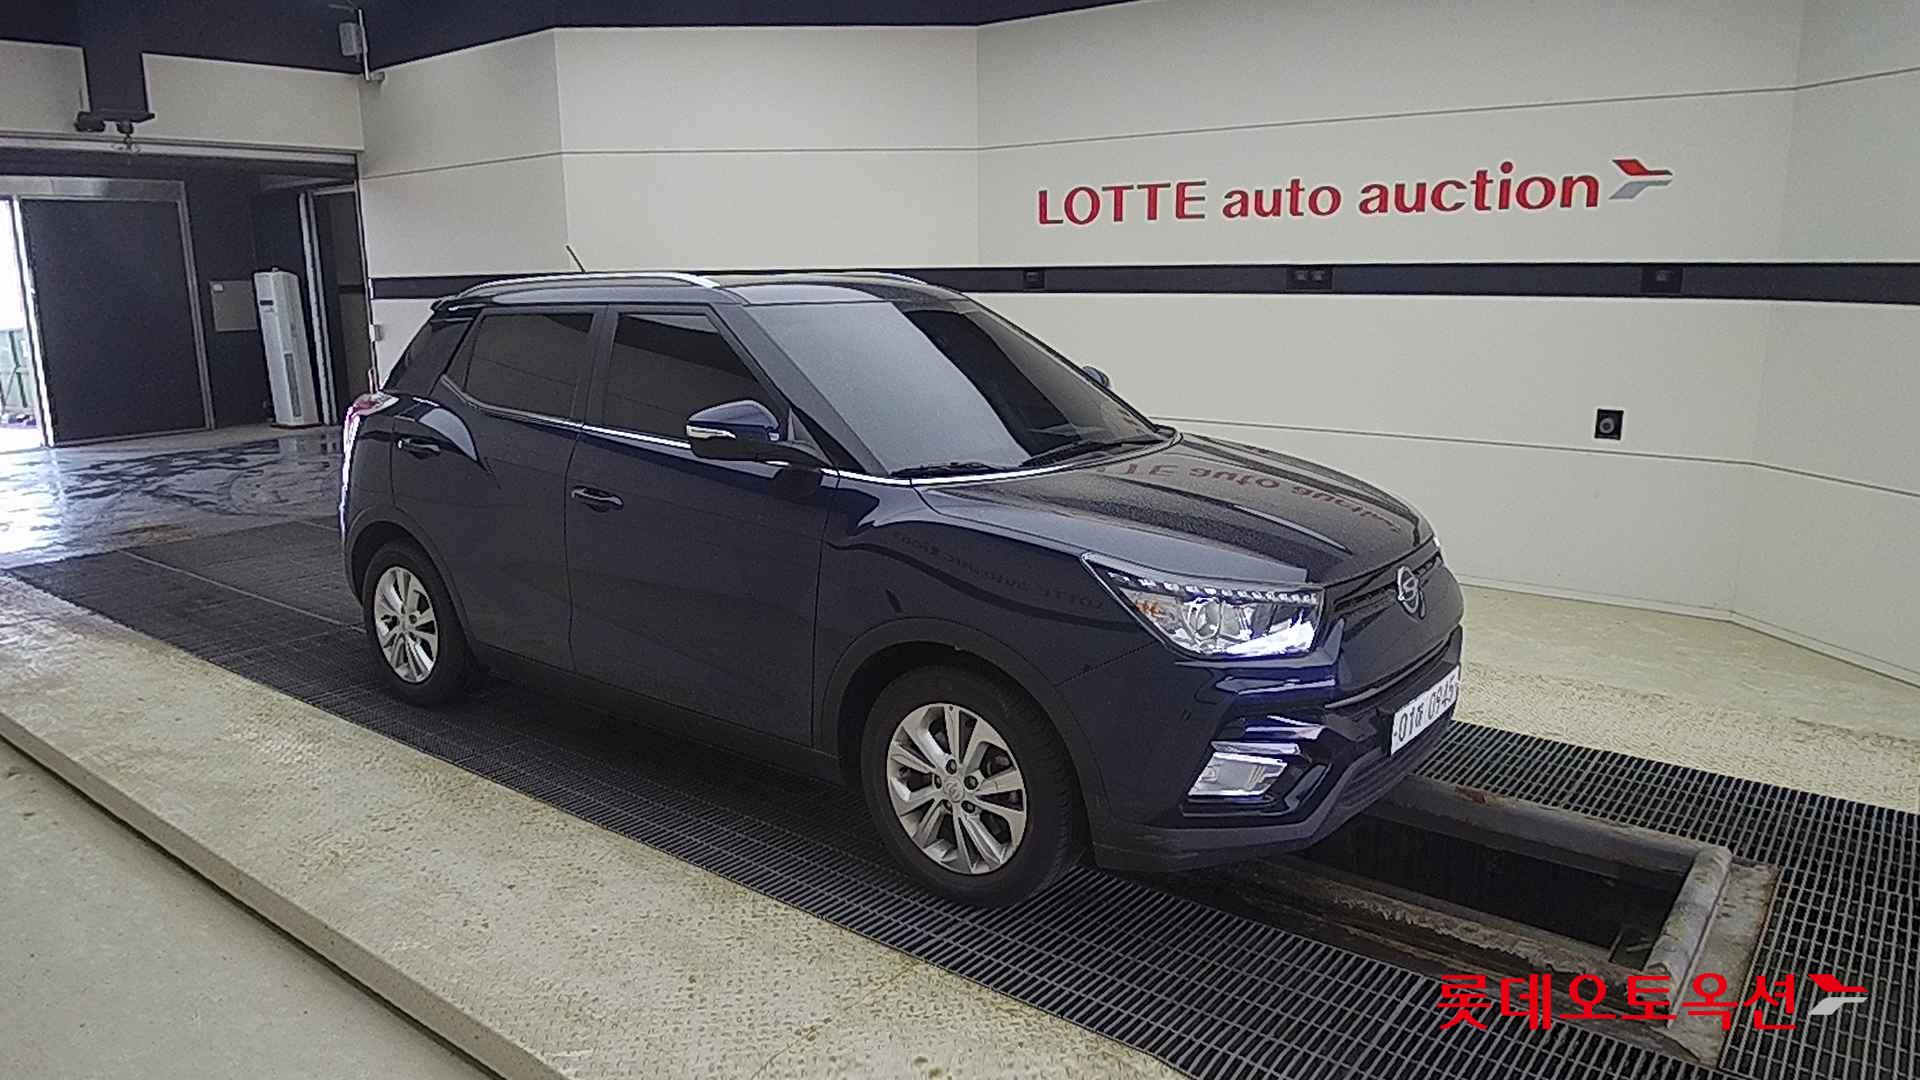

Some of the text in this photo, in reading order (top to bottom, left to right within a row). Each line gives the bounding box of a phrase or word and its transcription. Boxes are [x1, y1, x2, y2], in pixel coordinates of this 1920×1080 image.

[1038, 161, 1600, 225] LOTTE auto auction
